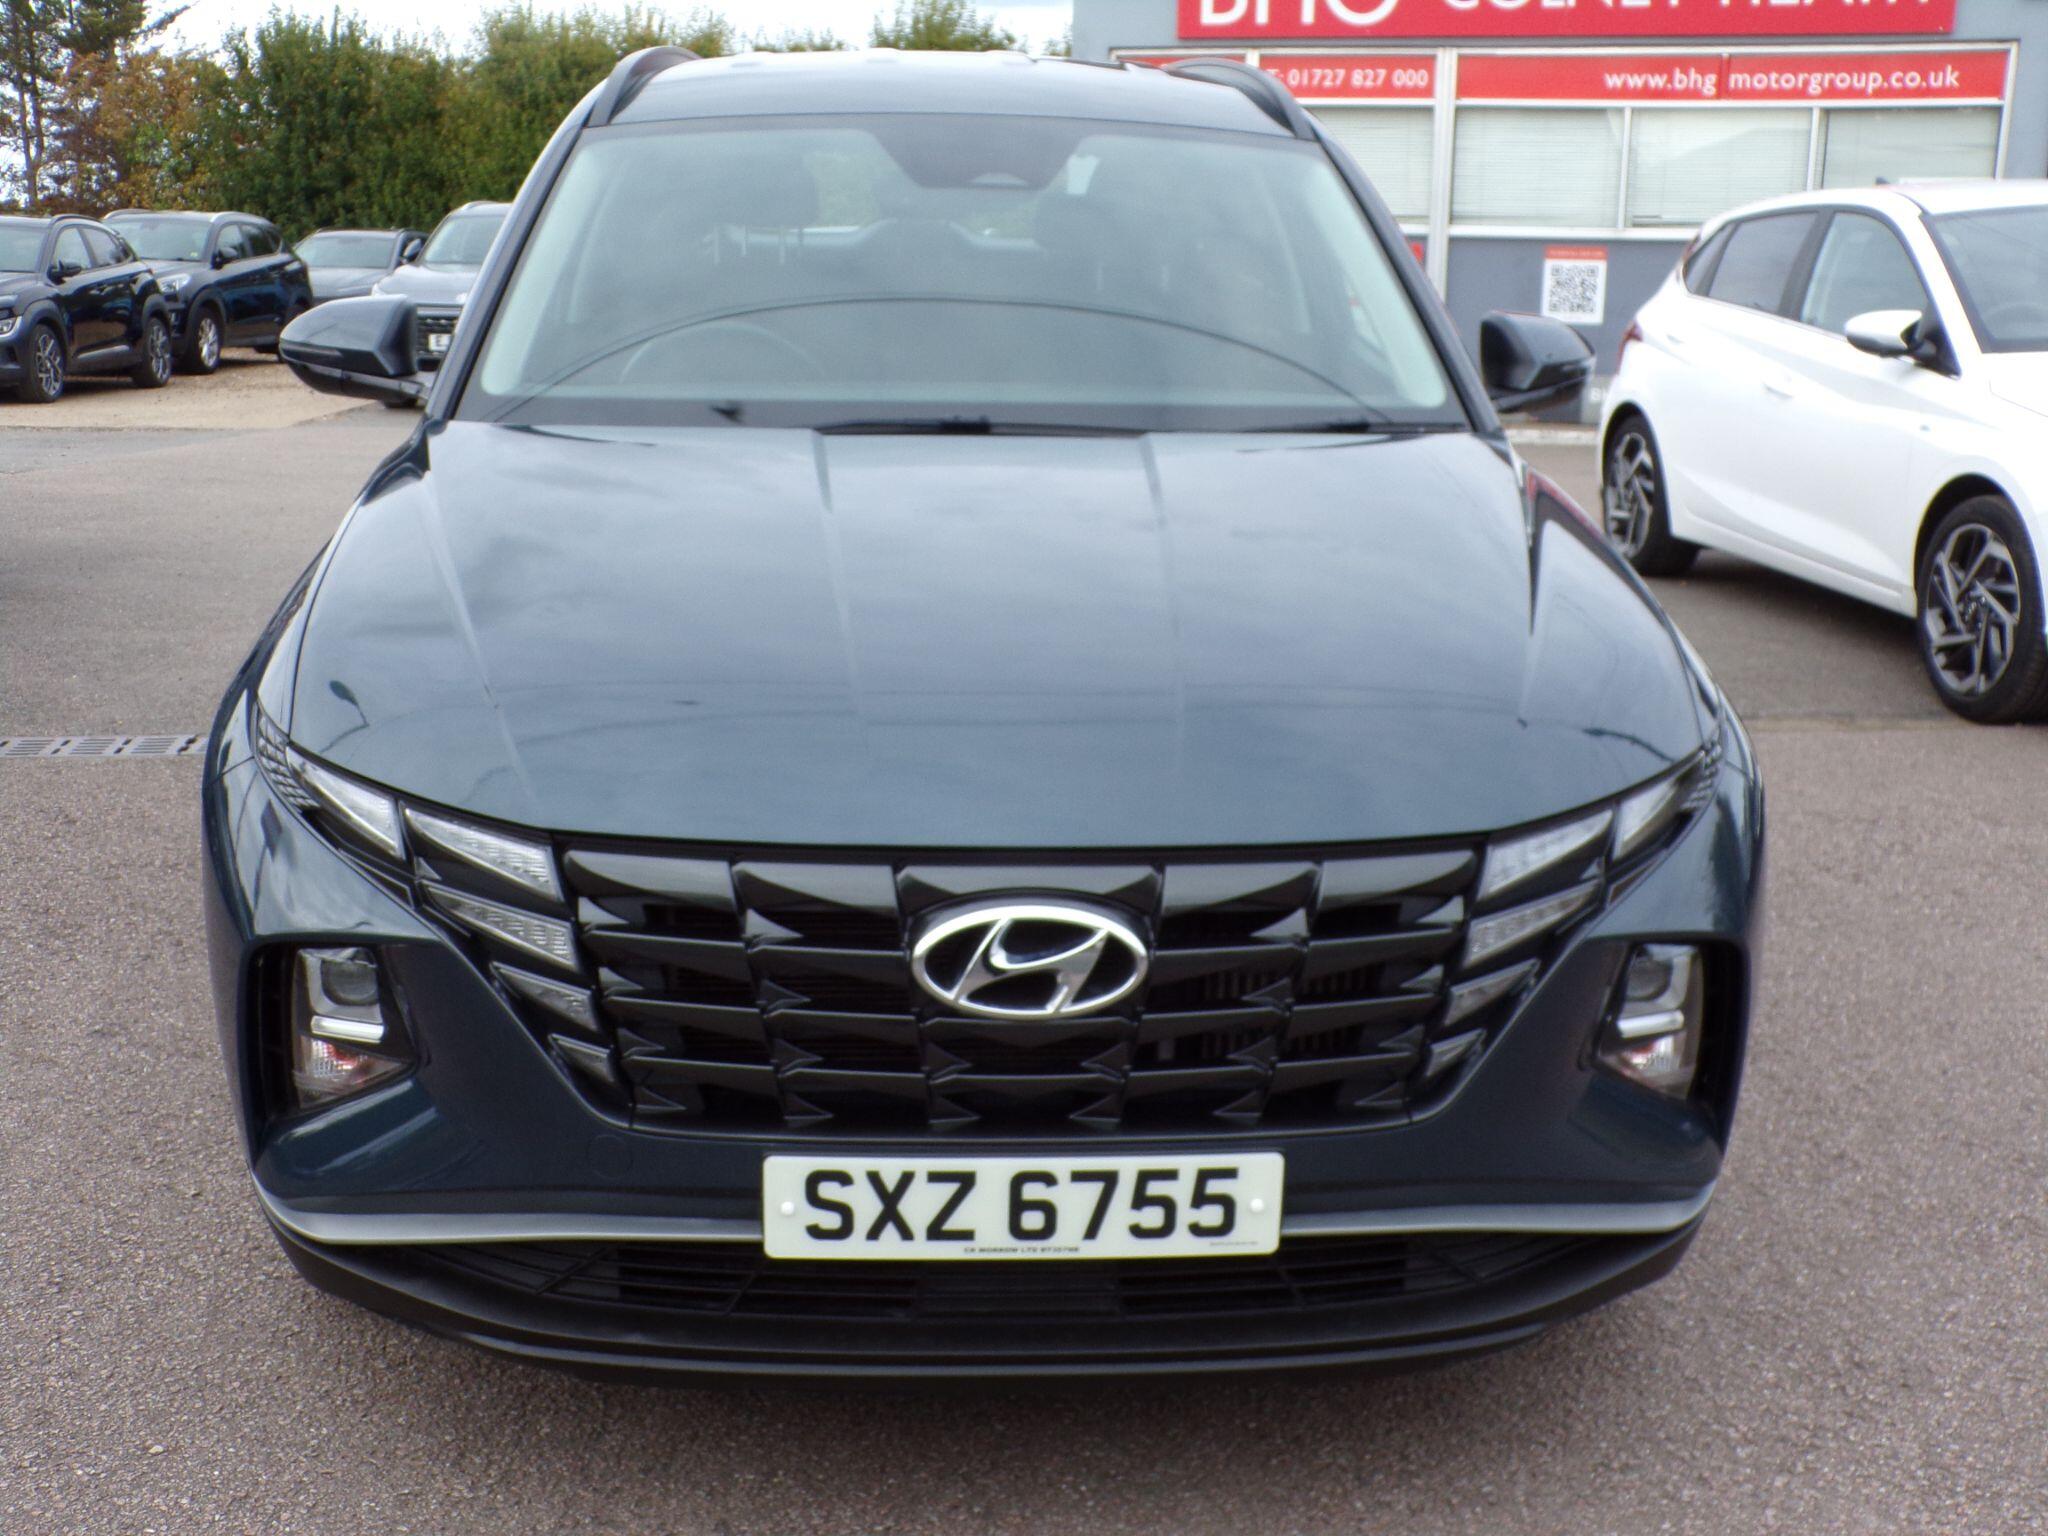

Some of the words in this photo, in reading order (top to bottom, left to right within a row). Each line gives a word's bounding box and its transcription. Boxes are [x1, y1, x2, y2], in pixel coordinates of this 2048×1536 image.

[1287, 68, 1346, 88] 01727
[1351, 68, 1387, 88] 827
[1392, 68, 1429, 88] 000
[1604, 67, 1717, 95] www.bhg
[1729, 65, 1960, 95] motorgroup.co.uk
[804, 1168, 977, 1242] SXZ
[1008, 1166, 1240, 1242] 6755
